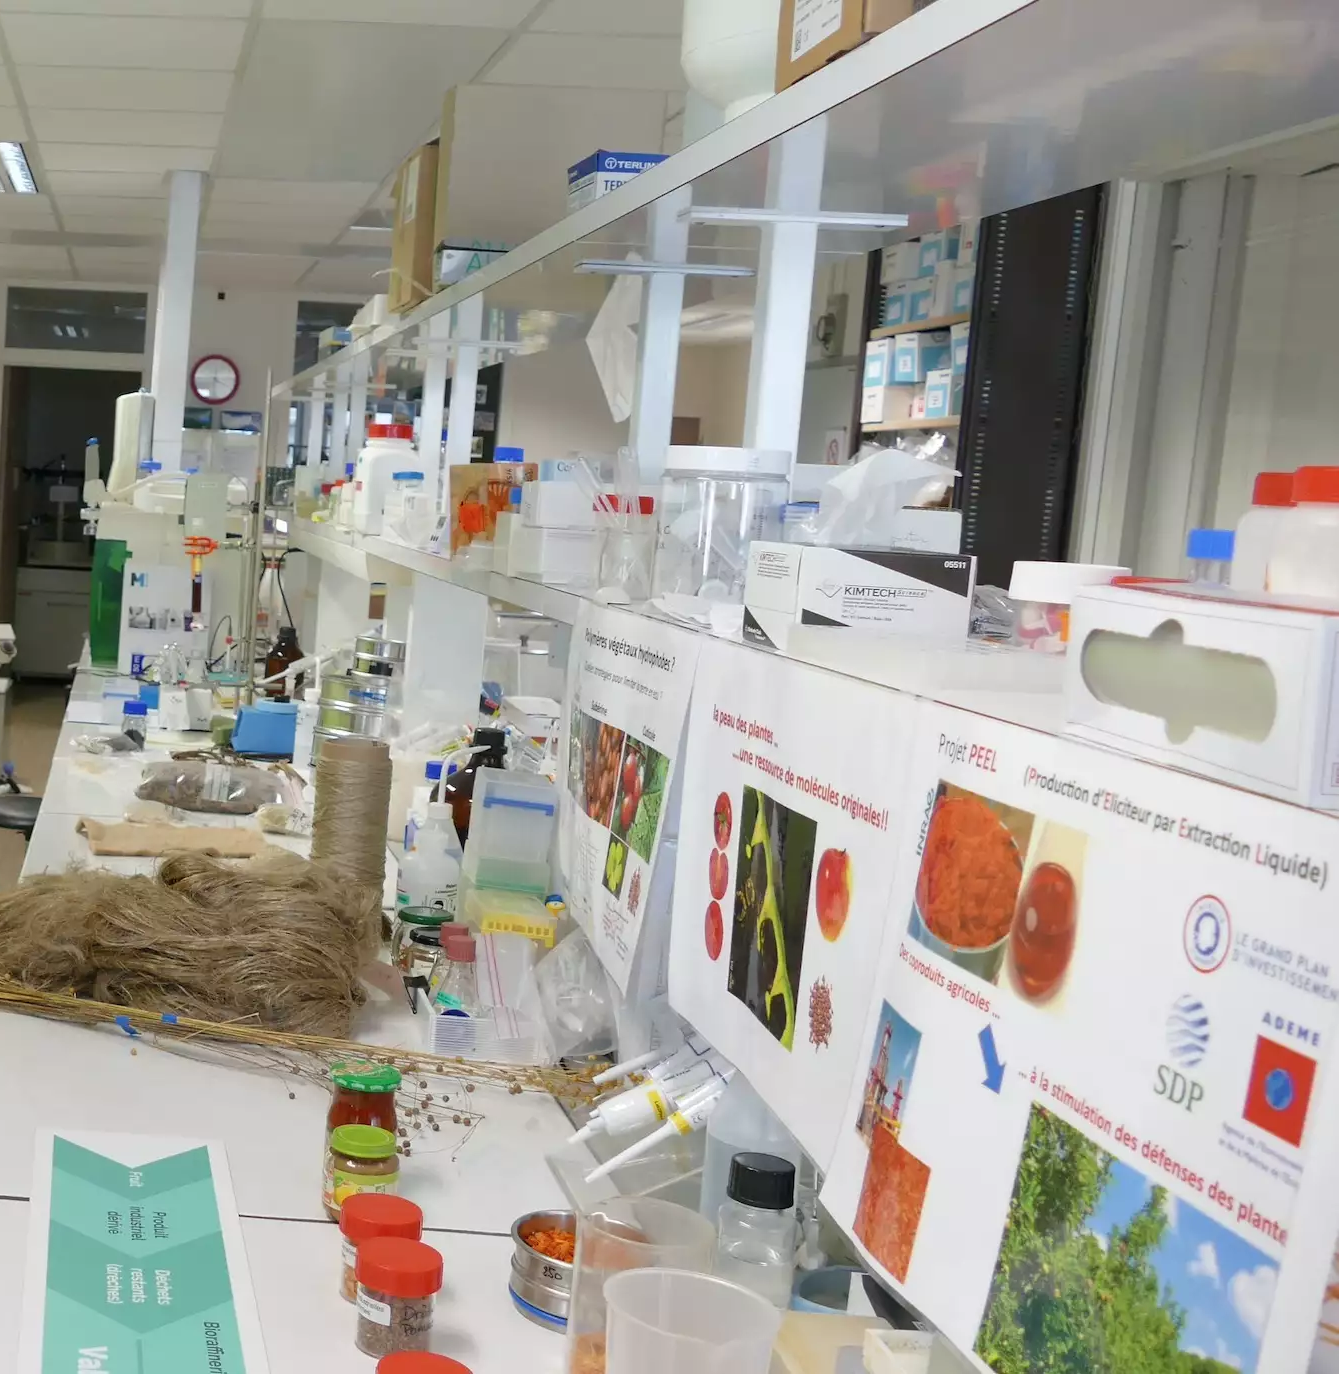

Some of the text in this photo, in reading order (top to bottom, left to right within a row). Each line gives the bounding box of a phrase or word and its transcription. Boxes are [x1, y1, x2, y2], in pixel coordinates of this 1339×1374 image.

[617, 160, 656, 169] TERUM
[944, 560, 967, 570] 05511
[844, 586, 896, 598] KIMTECH
[608, 637, 638, 657] végétaux
[638, 644, 671, 671] hydrophobes
[713, 704, 719, 721] la
[718, 710, 735, 728] peau
[735, 714, 747, 733] des
[748, 720, 774, 744] plantes
[938, 733, 997, 773] Projet PEEL
[754, 754, 784, 781] ressource
[784, 766, 795, 787] de
[796, 775, 840, 807] molécules
[841, 793, 889, 832] originales!!
[1023, 765, 1089, 802] (Production
[1152, 812, 1176, 833] par
[1178, 818, 1251, 860] Extraction
[1255, 843, 1329, 891] Liquide)
[899, 942, 909, 962] Des
[908, 955, 946, 988] coproduits
[946, 980, 991, 1013] agricoles
[1297, 954, 1330, 978] PLAN
[1262, 1011, 1320, 1047] ADEME
[1153, 1064, 1205, 1113] SDP
[1030, 1066, 1037, 1084] à
[1039, 1072, 1049, 1091] la
[1051, 1083, 1112, 1134] stimulation
[1114, 1124, 1138, 1151] des
[1141, 1140, 1205, 1193] défenses
[1208, 1181, 1234, 1211] des
[129, 1171, 144, 1187] Fruit
[107, 1211, 123, 1235] dérivé
[129, 1206, 146, 1241] industriel
[153, 1211, 169, 1238] Produit
[130, 1268, 147, 1303] restants
[155, 1269, 173, 1305] Déchets
